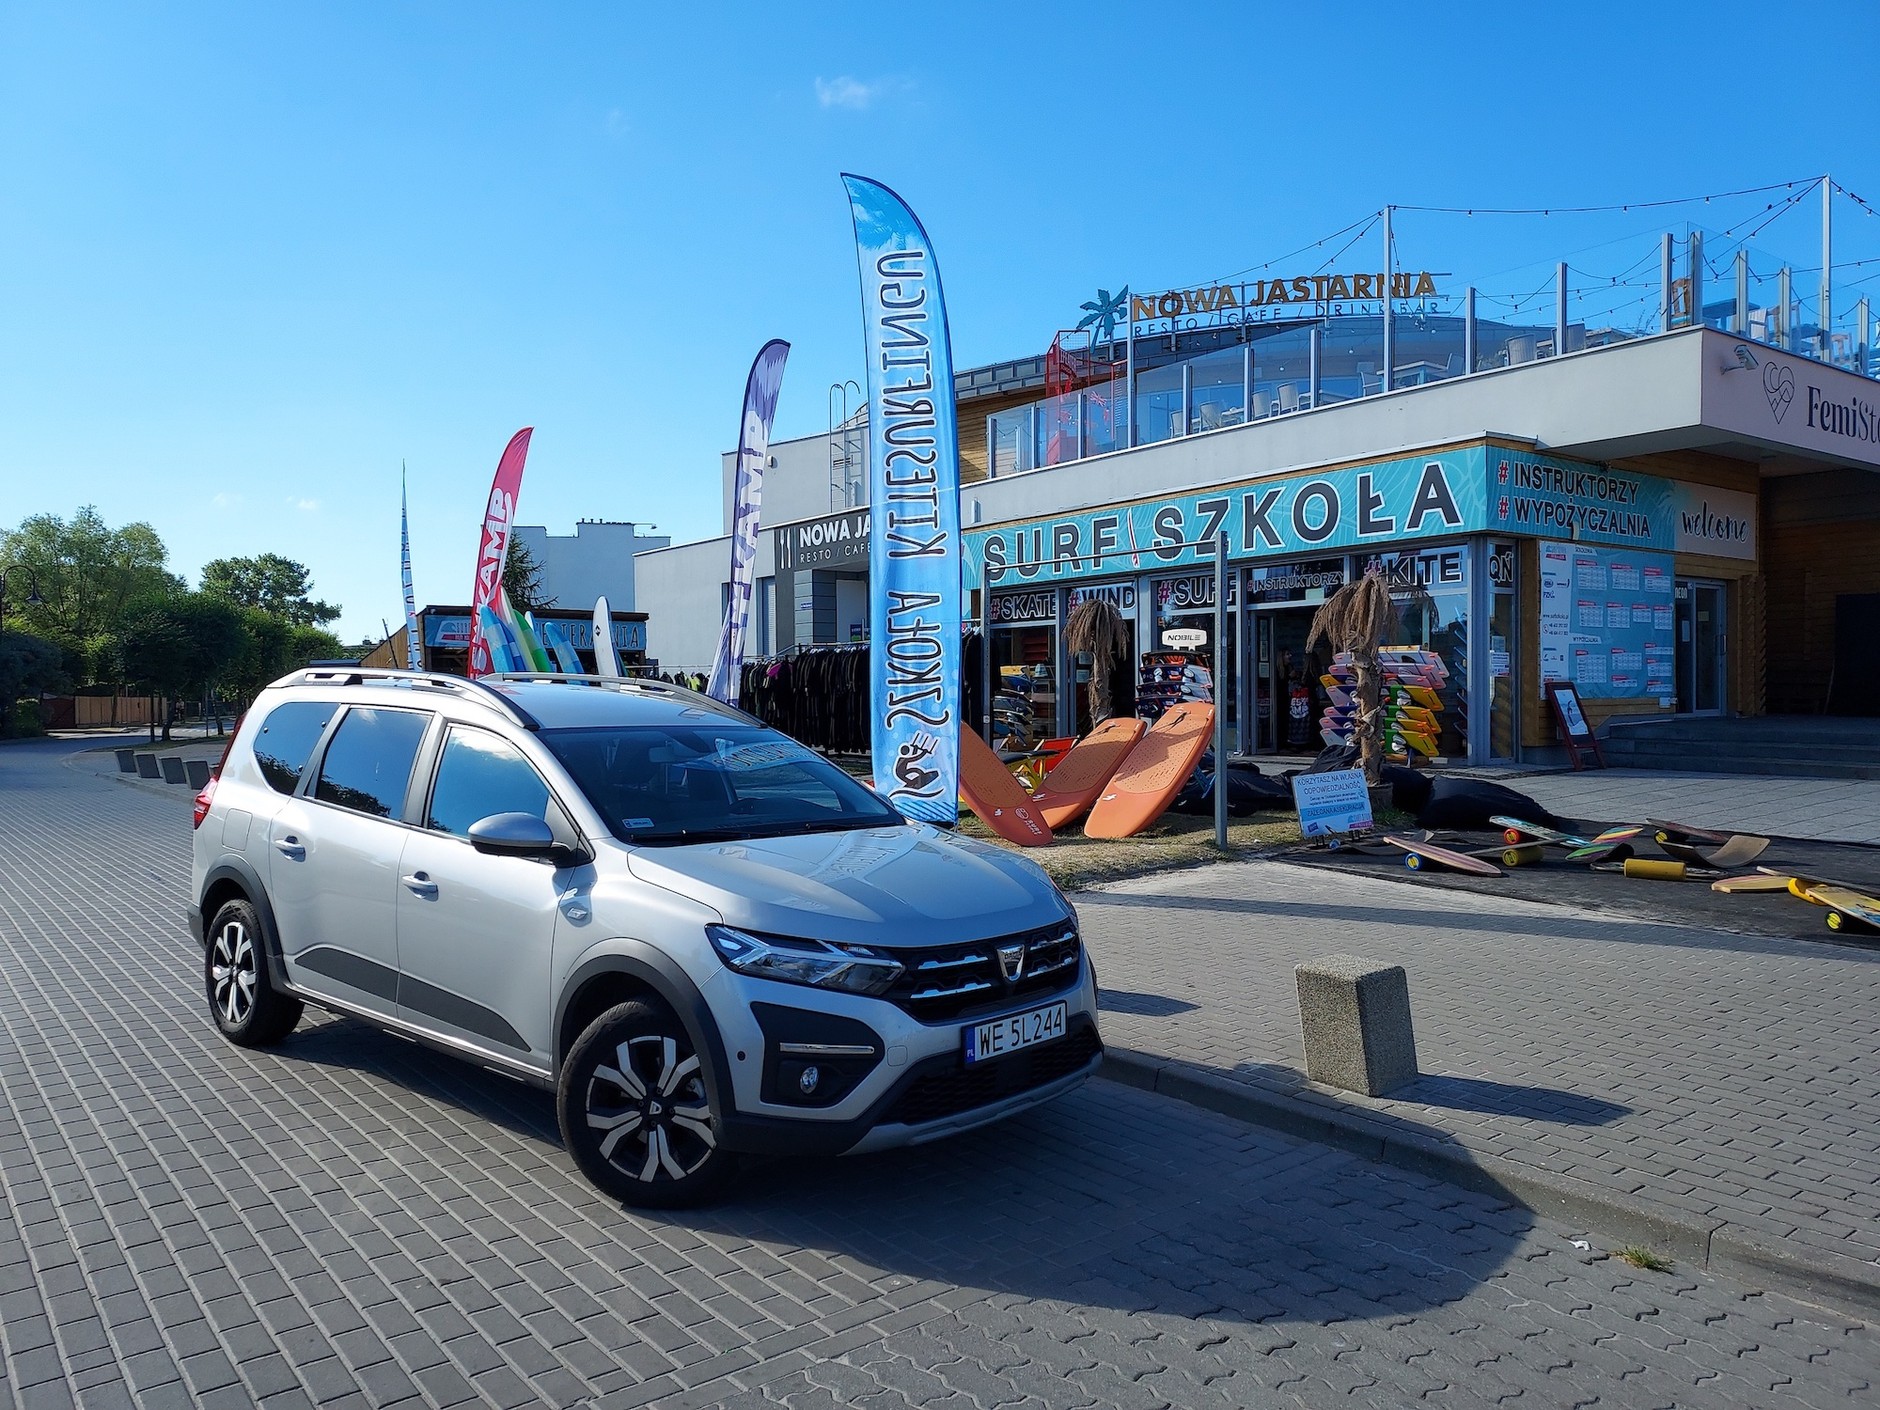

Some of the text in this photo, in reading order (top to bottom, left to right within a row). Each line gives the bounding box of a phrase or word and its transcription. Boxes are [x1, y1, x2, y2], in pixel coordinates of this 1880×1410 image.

[1132, 271, 1438, 321] NOWA JASTARNIA
[1134, 319, 1198, 337] RESTO
[1227, 308, 1281, 326] CAFE
[1514, 461, 1640, 505] INSTRUKTORZY
[800, 514, 871, 548] NOWA JA
[984, 461, 1465, 582] SURF SZKOŁA
[1514, 496, 1651, 539] WYPOŻYCZALNIA
[1682, 501, 1750, 545] welcome
[800, 549, 831, 564] RESTO
[1247, 571, 1344, 592] #INSTRUKTORZY
[990, 592, 1056, 620] #SKATE
[980, 1006, 1062, 1056] WE 5L244
[967, 1049, 975, 1058] PL
